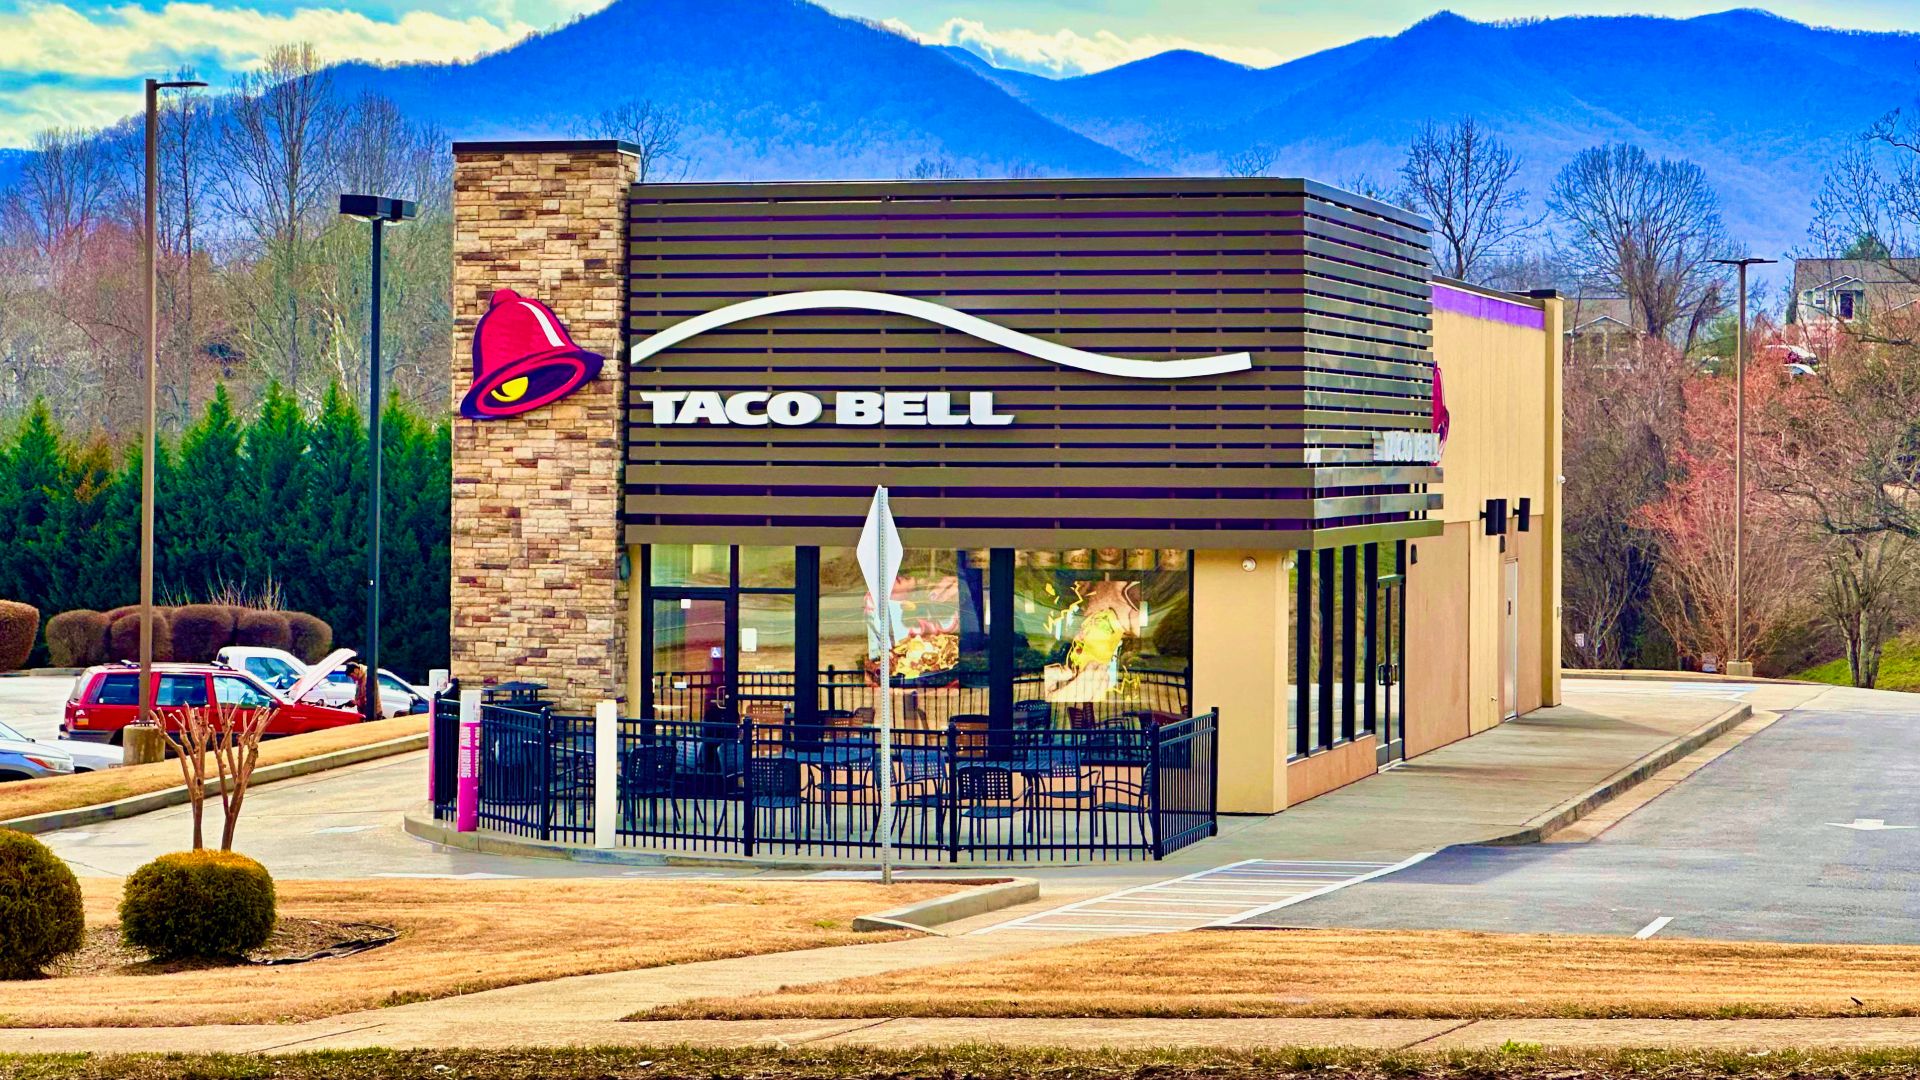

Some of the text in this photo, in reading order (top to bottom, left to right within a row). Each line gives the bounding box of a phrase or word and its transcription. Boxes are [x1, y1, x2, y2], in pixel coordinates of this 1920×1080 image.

[641, 391, 1016, 425] TACO BELL
[460, 727, 471, 778] NOW HIRING
